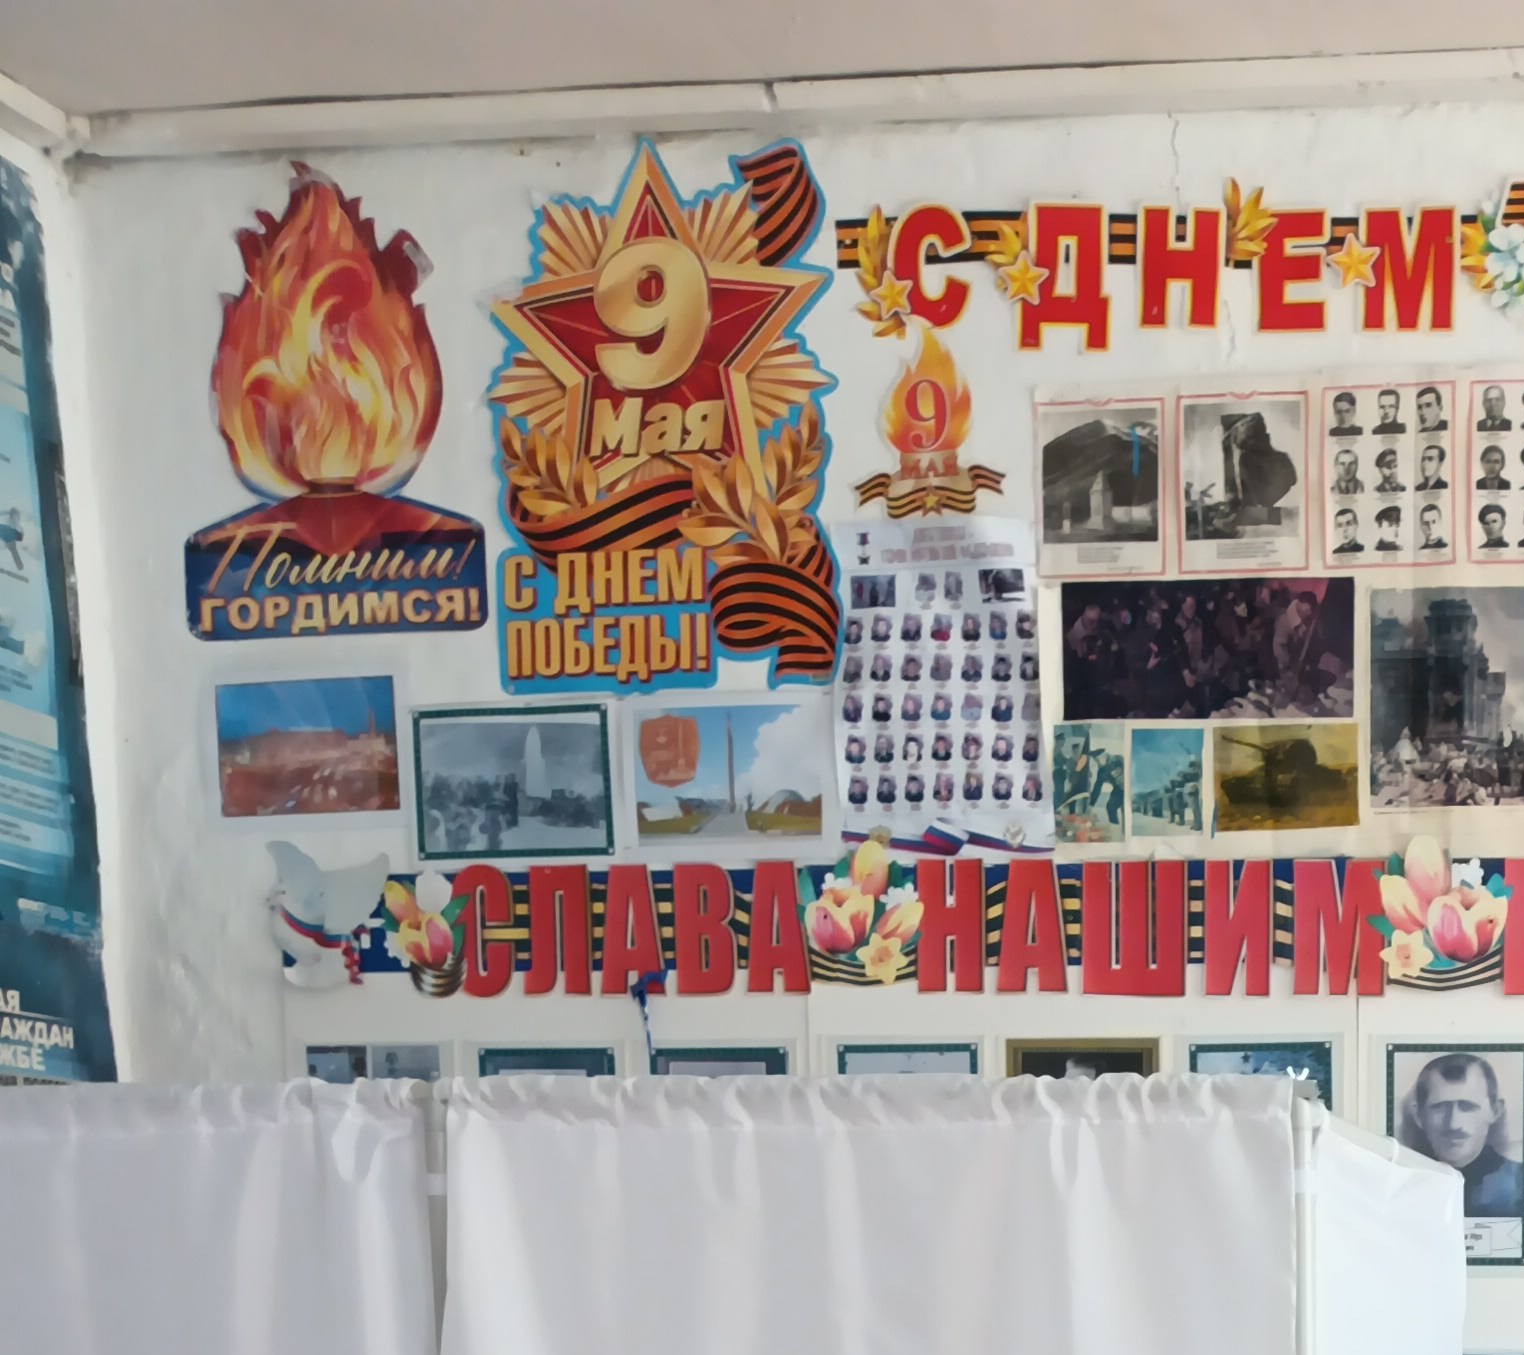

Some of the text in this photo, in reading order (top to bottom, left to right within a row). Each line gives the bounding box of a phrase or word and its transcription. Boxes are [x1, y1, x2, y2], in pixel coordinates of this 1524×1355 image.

[892, 203, 972, 330] С
[1016, 203, 1458, 352] ДНЕМ
[594, 238, 710, 390] 9
[590, 398, 728, 460] Мая
[905, 379, 947, 450] 9
[900, 454, 960, 481] МАЯ
[207, 521, 477, 593] Помним!
[504, 547, 707, 618] С ДНЕМ
[200, 586, 482, 633] ГОРДИМСЯ!
[506, 610, 709, 683] ПОБЕДЫ!
[451, 861, 811, 998] СЛАВА
[916, 857, 1388, 997] НАШИМ
